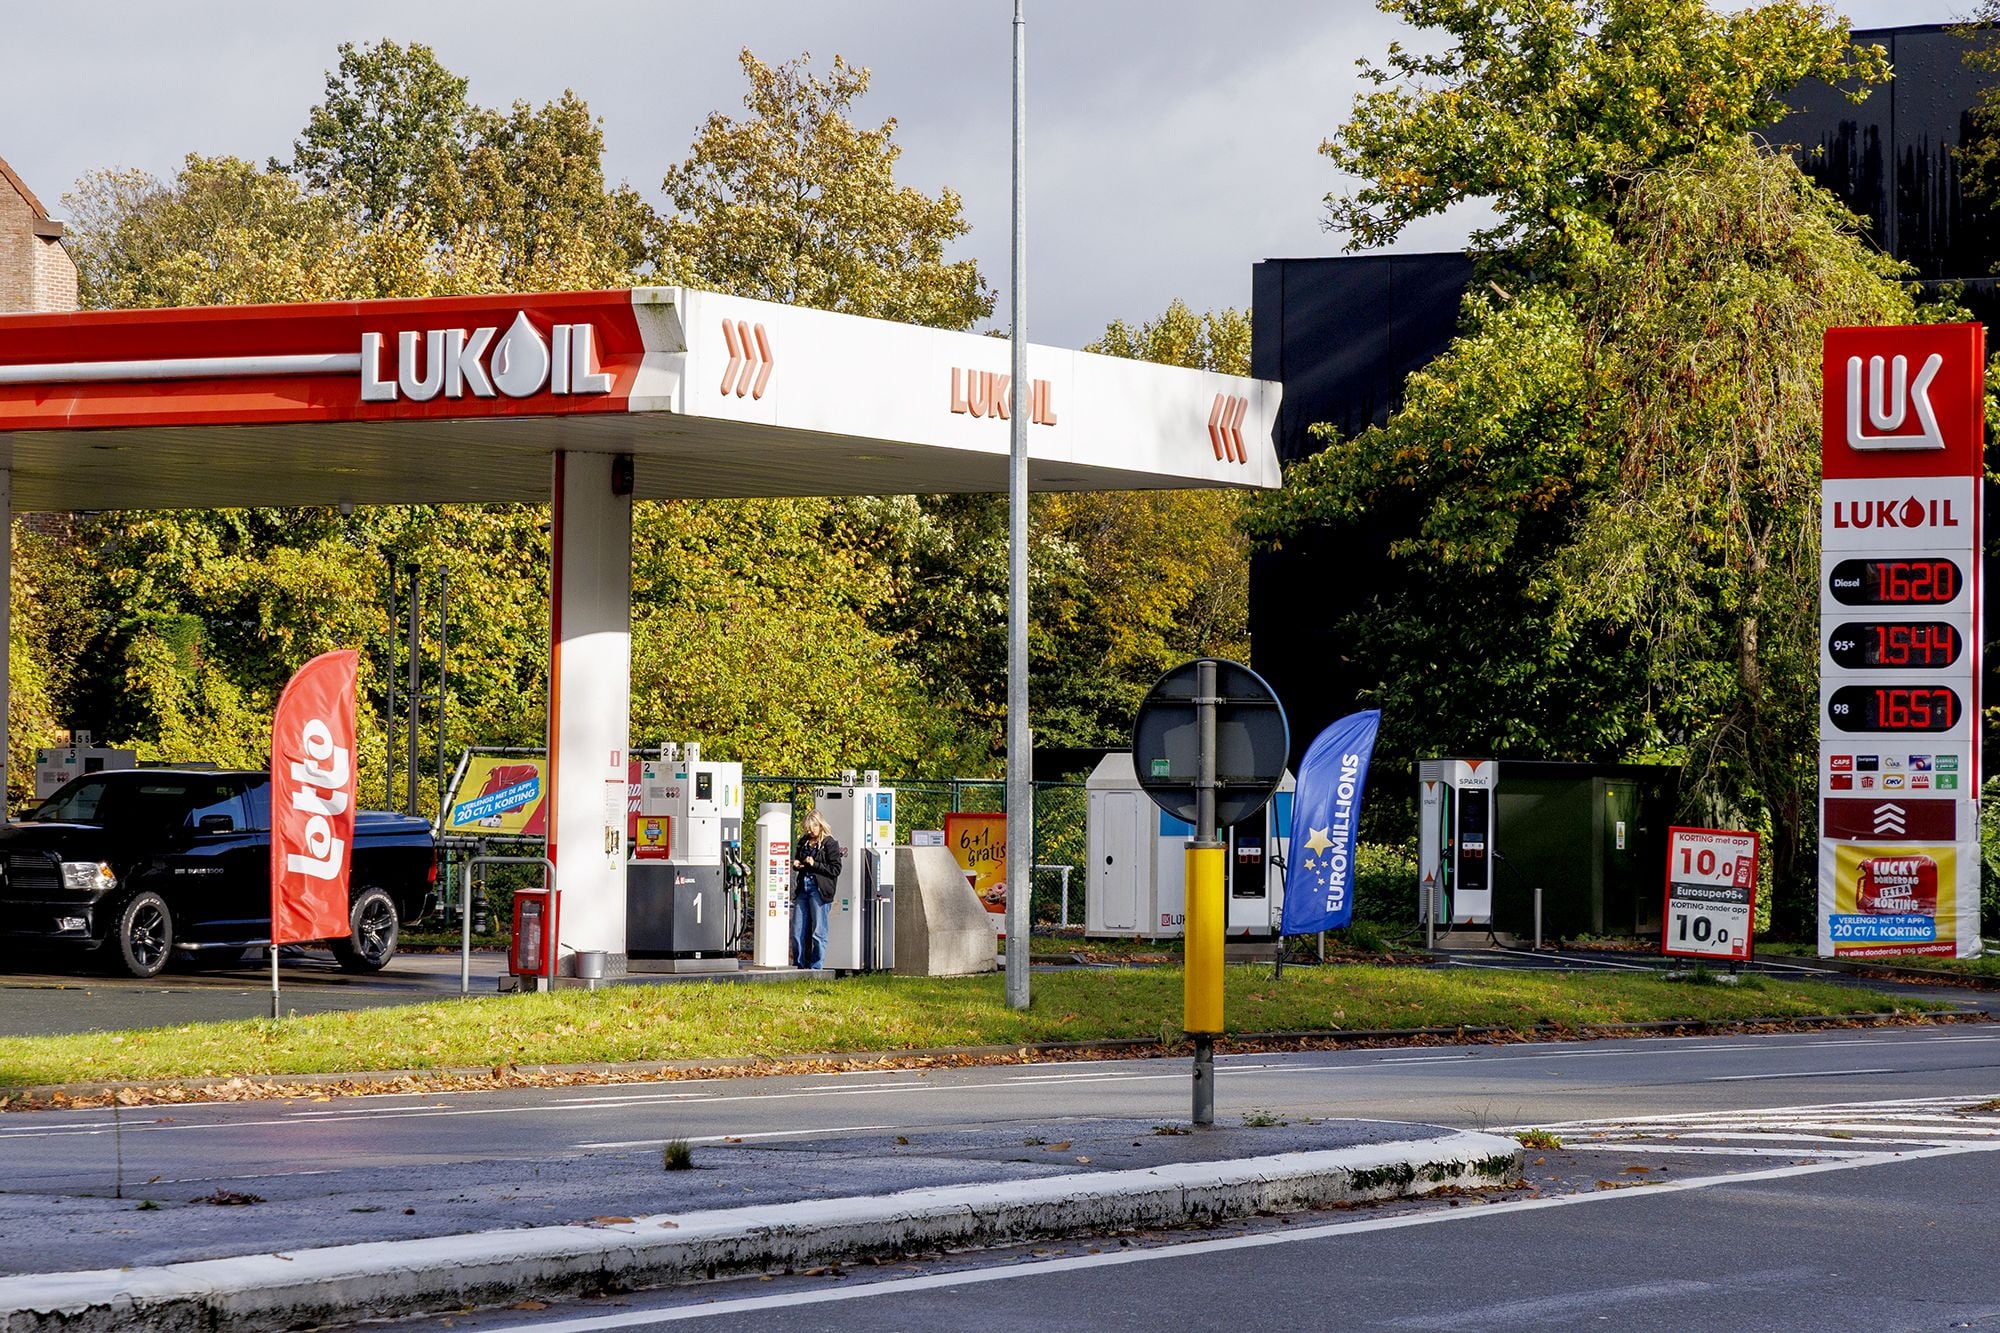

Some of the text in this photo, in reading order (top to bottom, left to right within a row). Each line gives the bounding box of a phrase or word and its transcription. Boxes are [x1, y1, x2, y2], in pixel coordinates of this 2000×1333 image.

[361, 310, 613, 401] LUKOIL
[951, 367, 1056, 426] LUKIL
[1847, 353, 1945, 450] LUK
[1834, 496, 1958, 529] LUKOIL
[1834, 578, 1860, 588] Diesel
[1834, 641, 1856, 651] 95+
[1834, 703, 1849, 714] 98
[38, 749, 43, 758] 6
[70, 749, 76, 758] 5
[663, 748, 669, 757] 2
[644, 763, 651, 773] 2
[681, 763, 686, 773] 1
[866, 774, 872, 783] 9
[496, 791, 508, 800] MET
[814, 788, 824, 798] 10
[848, 788, 854, 798] 9
[287, 719, 350, 880] Lotto
[457, 789, 536, 822] 20 CT/L KORTING
[960, 827, 989, 849] 6+1
[1326, 753, 1360, 913] EUROMILLIONS
[1679, 834, 1714, 843] KORTING
[968, 841, 1006, 867] gratis
[1680, 847, 1733, 880] 10,0
[1873, 860, 1920, 876] LUCKY
[1874, 876, 1919, 885] DONDERDAG
[1881, 885, 1910, 897] EXTRA
[693, 892, 702, 924] 1
[1671, 901, 1704, 909] KORTING
[1705, 904, 1731, 912] zonder
[1874, 898, 1919, 911] KORTING
[1676, 914, 1728, 947] 10,0
[1834, 925, 1852, 936] 20
[1853, 926, 1878, 937] CT/L
[1865, 948, 1901, 956] donderdag
[1918, 945, 1953, 953] goedkoper
